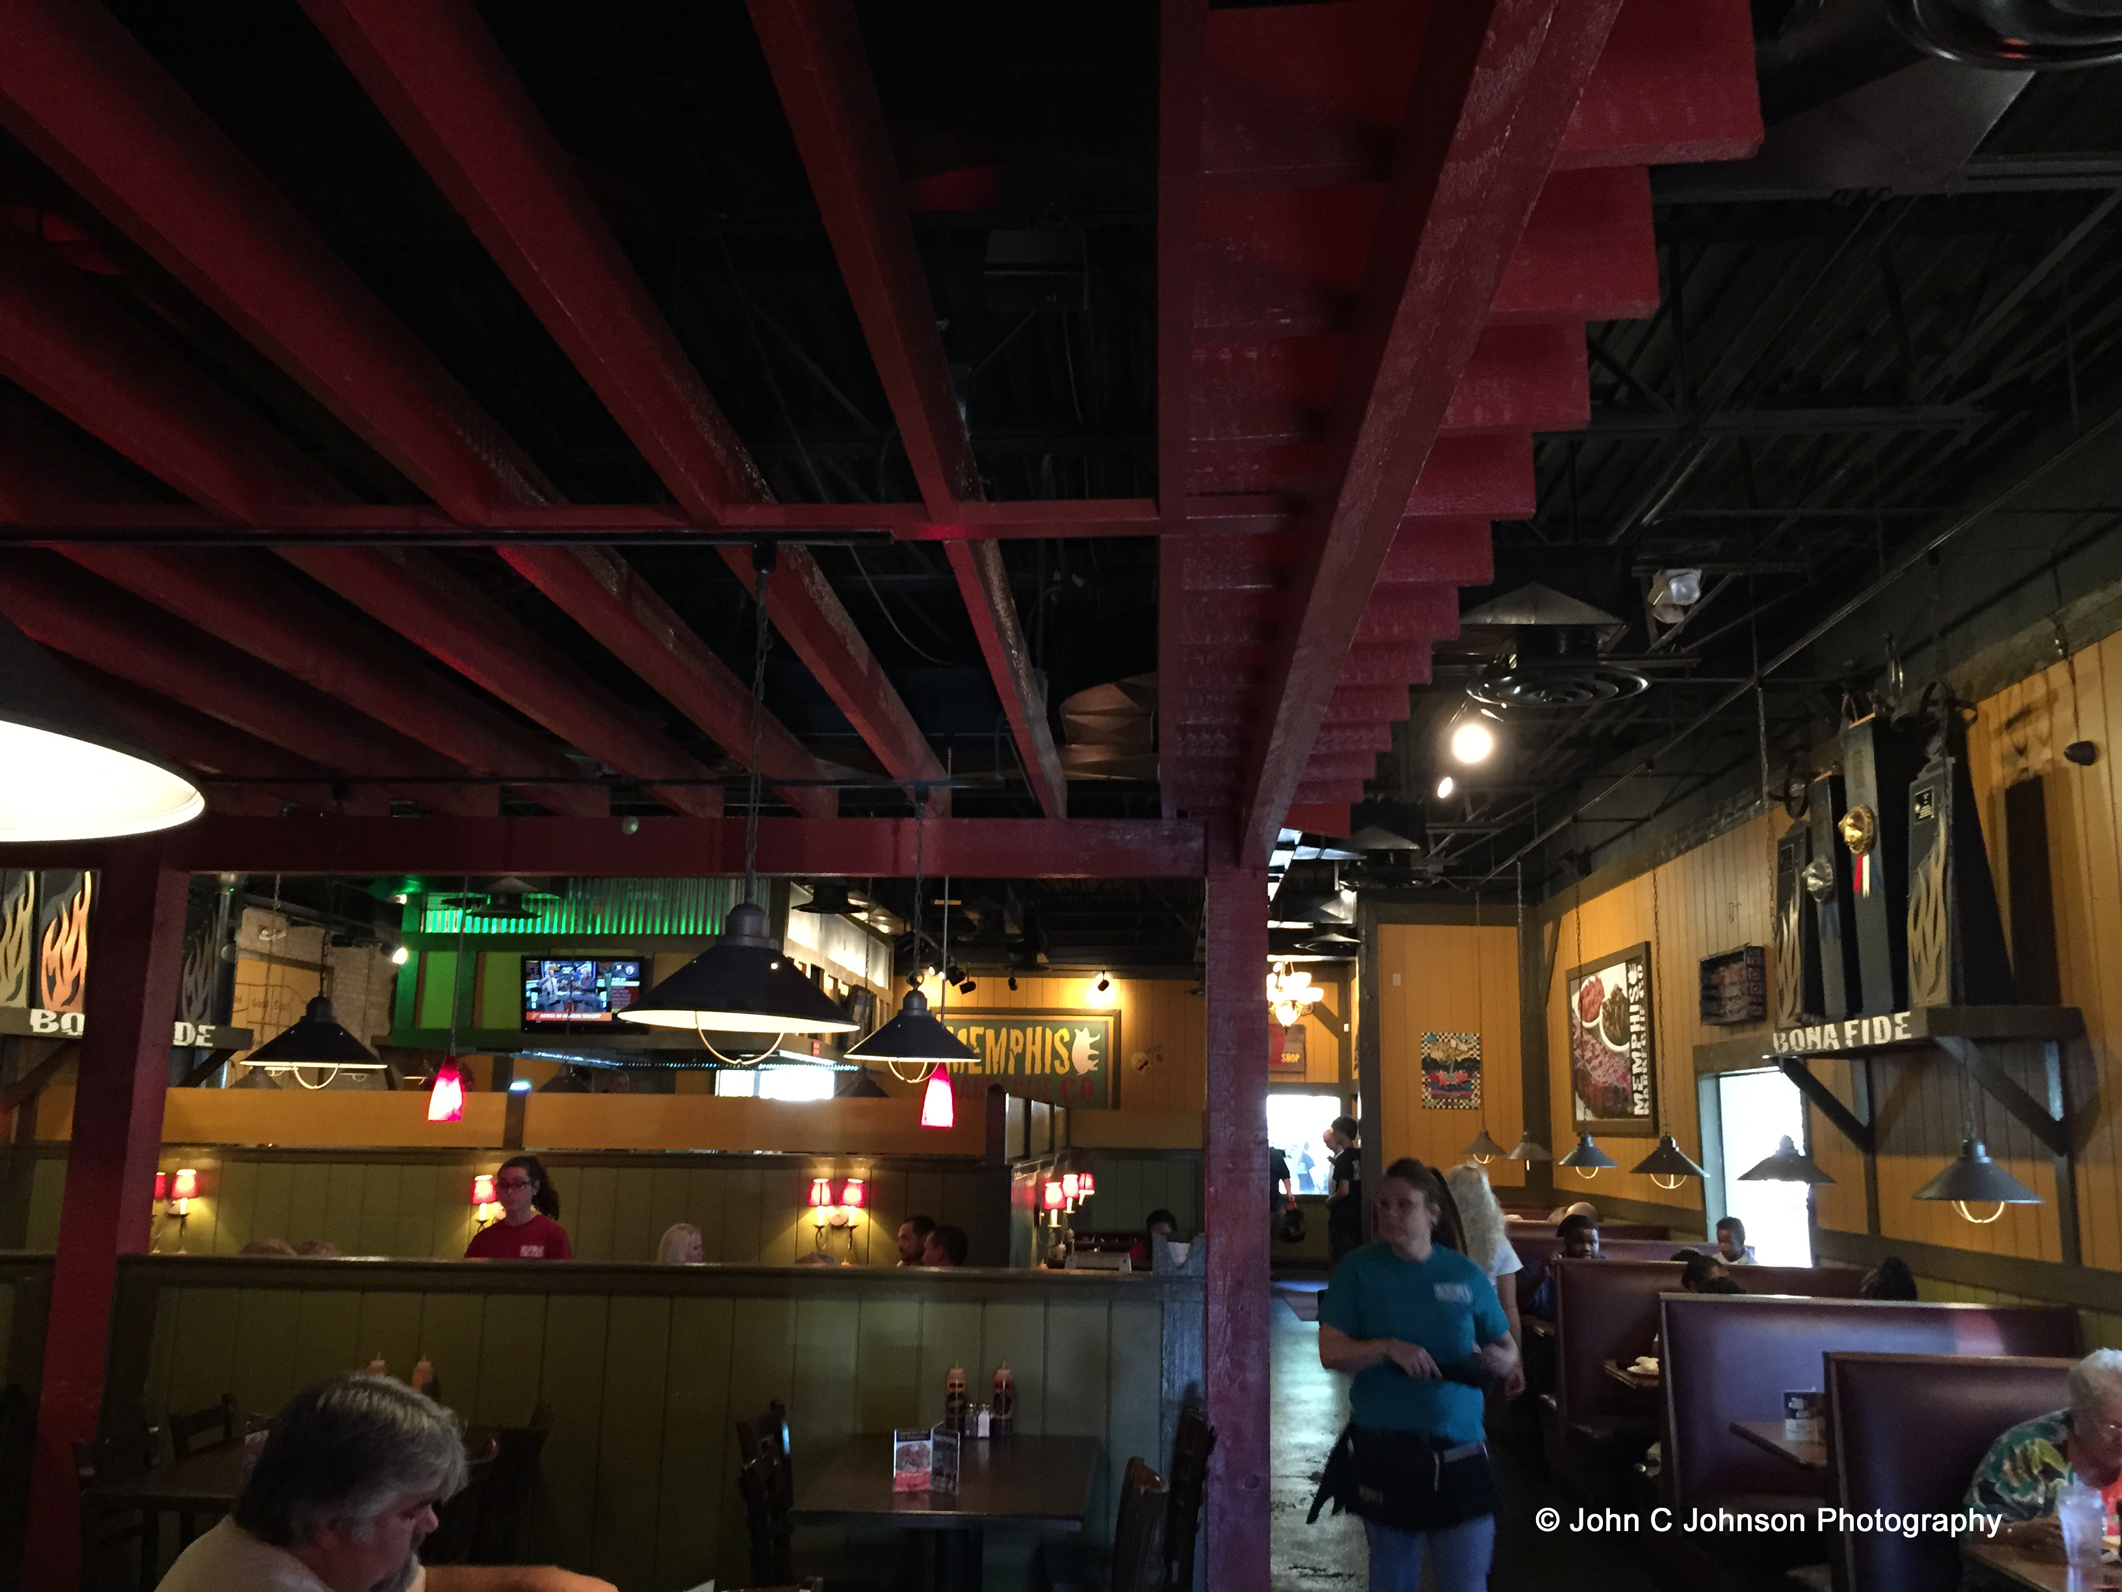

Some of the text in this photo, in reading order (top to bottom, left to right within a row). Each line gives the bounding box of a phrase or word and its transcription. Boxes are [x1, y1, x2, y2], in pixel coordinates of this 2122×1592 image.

[946, 1026, 1070, 1075] MEMPHIS
[1628, 985, 1645, 1115] MEMPHIS
[1772, 1011, 1913, 1054] BONA FIDE
[1281, 1053, 1300, 1063] SHOP
